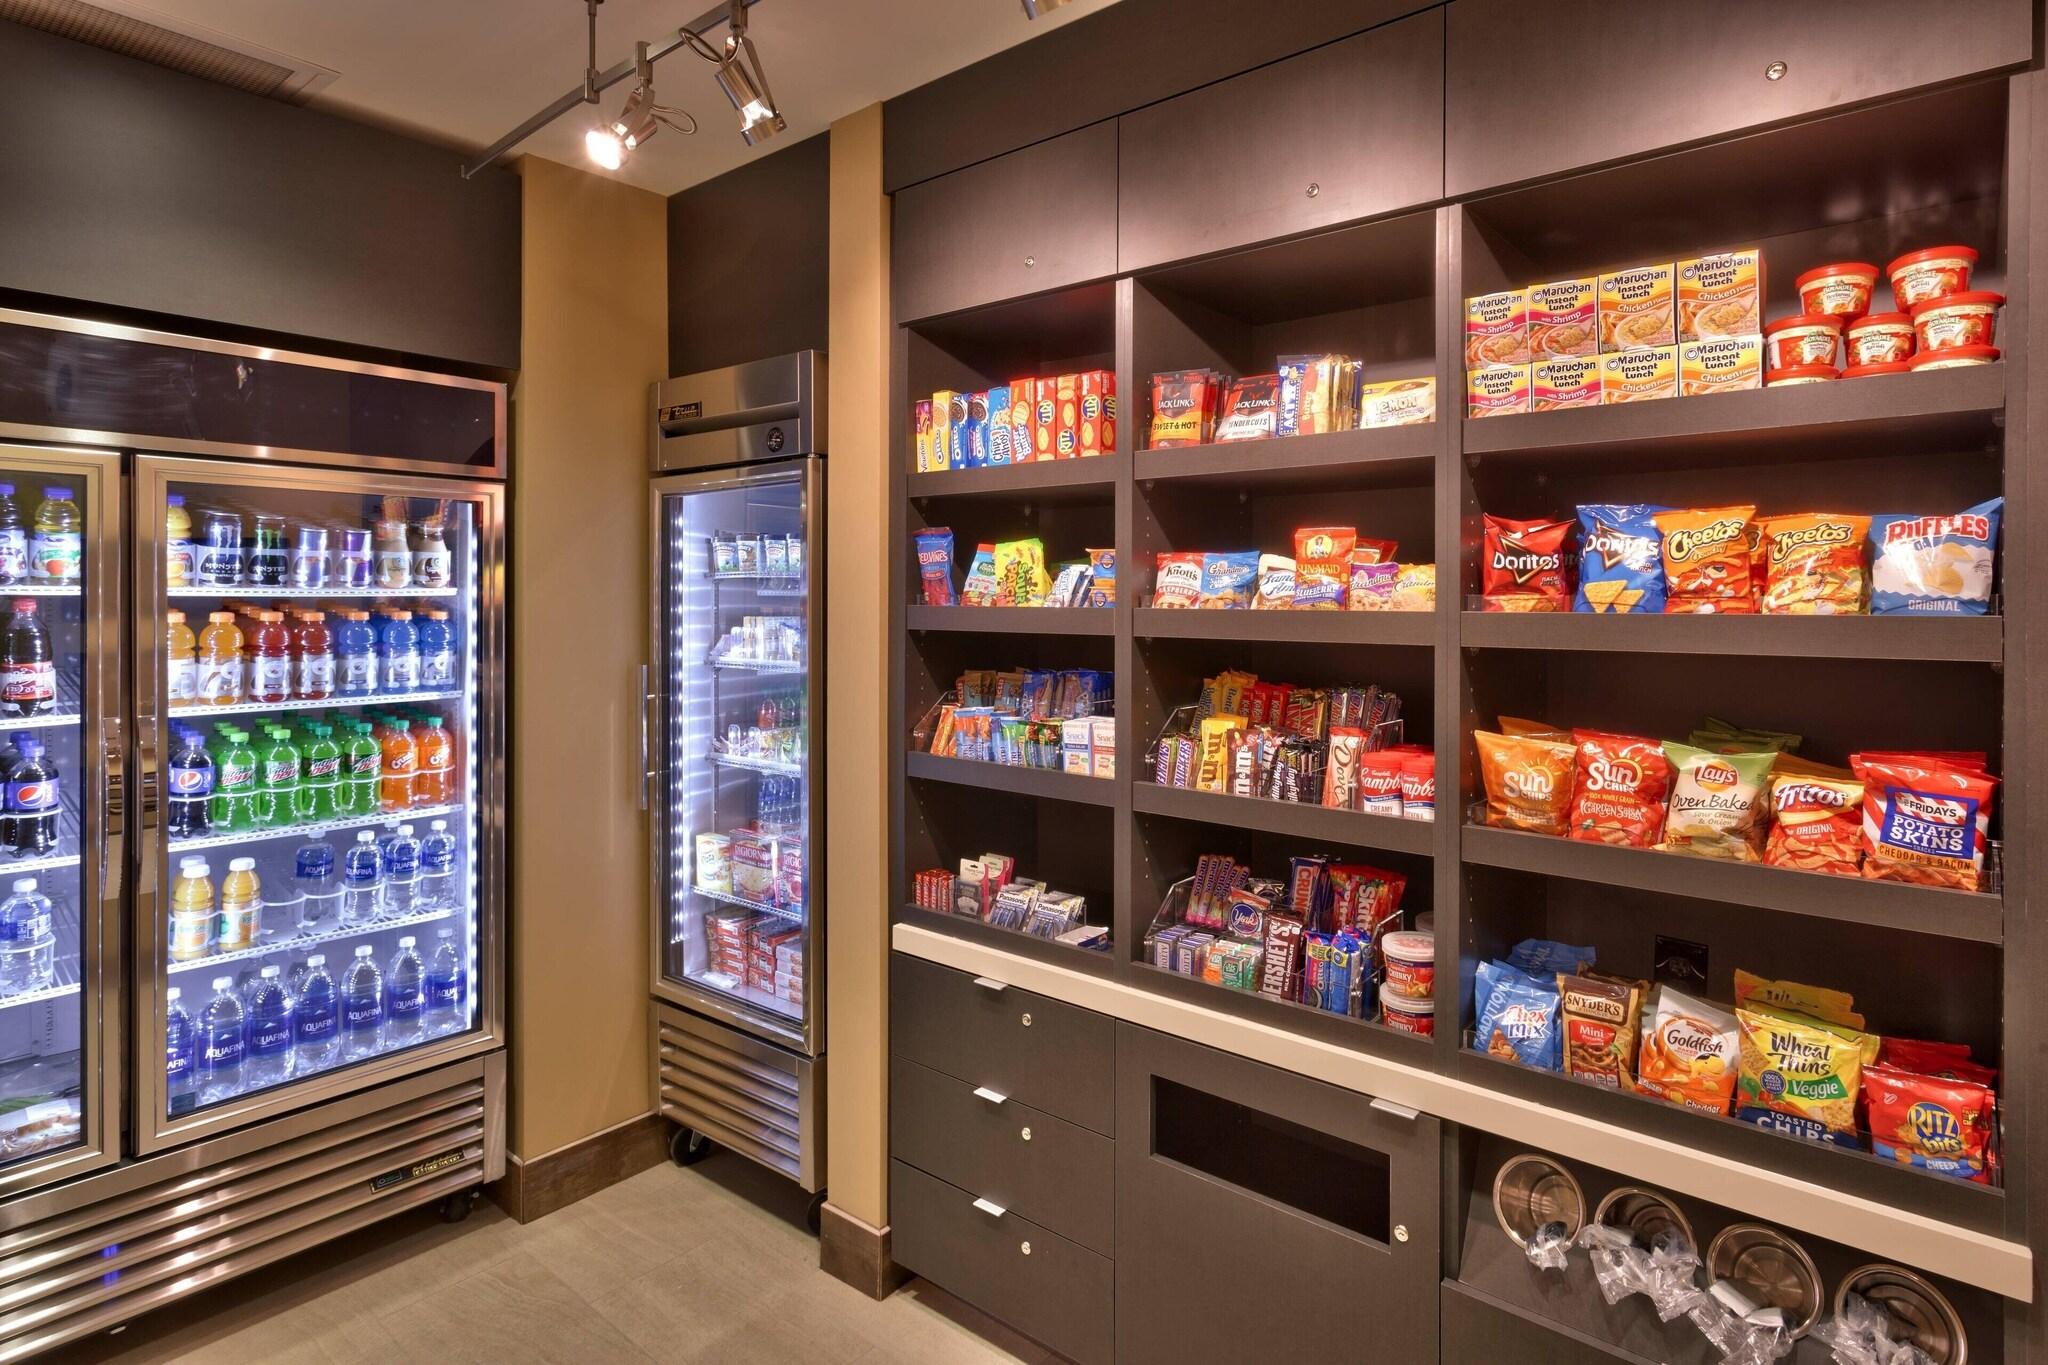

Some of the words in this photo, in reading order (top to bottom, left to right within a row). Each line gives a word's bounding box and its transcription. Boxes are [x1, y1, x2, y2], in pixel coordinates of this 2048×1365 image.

[1693, 256, 1751, 273] Maruchan
[1614, 270, 1667, 285] Maruchan
[1698, 268, 1737, 281] Instant
[1618, 282, 1654, 293] Instant
[1702, 278, 1733, 288] Lunch
[1542, 284, 1591, 298] Maruchan
[1621, 290, 1650, 300] Lunch
[1698, 287, 1736, 301] Chicken
[1478, 295, 1522, 308] Maruchan
[1545, 295, 1578, 305] Instant
[1549, 302, 1575, 311] Lunch
[1618, 299, 1652, 313] Chicken
[1481, 306, 1511, 316] Instant
[1484, 313, 1508, 322] Lunch
[1552, 311, 1581, 324] Shrimp
[1487, 321, 1514, 334] Shrimp
[1697, 340, 1754, 354] Maruchan
[1618, 352, 1670, 365] Maruchan
[1701, 351, 1740, 363] Instant
[1705, 360, 1736, 369] Lunch
[1547, 362, 1596, 374] Maruchan
[1621, 363, 1658, 373] Instant
[1625, 370, 1654, 379] Lunch
[1481, 370, 1523, 382] Maruchan
[1550, 372, 1584, 382] Instant
[1554, 379, 1580, 388] Lunch
[1701, 371, 1738, 383] Chicken
[1484, 380, 1513, 389] Instant
[1487, 387, 1510, 395] Lunch
[1621, 381, 1656, 392] Chicken
[1490, 394, 1516, 407] Shrimp
[1558, 388, 1588, 400] Shrimp
[1085, 397, 1097, 418] RITZ
[1158, 400, 1173, 409] JACK
[1233, 401, 1249, 410] JACK
[1040, 402, 1052, 423] RITZ
[1154, 422, 1174, 431] SWEET
[1174, 422, 1179, 430] &
[1181, 422, 1197, 430] HOT
[935, 430, 944, 463] OREO
[953, 426, 961, 461] OREO
[975, 426, 984, 460] OREO
[1060, 431, 1072, 451] RITZ
[993, 437, 1003, 461] Chips
[1887, 514, 1989, 543] RUFFLES
[1585, 535, 1659, 557] Doritos
[1668, 521, 1743, 561] Cheetos
[1772, 525, 1852, 563] Cheetos
[1494, 552, 1559, 571] Doritos
[1166, 566, 1198, 582] Knott's
[1016, 562, 1027, 604] SOUR
[1908, 599, 1961, 613] ORIGINAL
[1066, 731, 1086, 741] Snack
[1586, 761, 1638, 791] Sun
[1697, 765, 1737, 784] Lay's
[1504, 770, 1553, 797] Sun
[1603, 781, 1635, 794] CHIPS
[1520, 791, 1552, 801] CHIPS
[1673, 793, 1709, 809] Oven
[1775, 783, 1848, 811] Fritos
[1909, 800, 1957, 817] FRIDAYS
[1796, 823, 1835, 834] ORIGINAL
[1893, 815, 1964, 838] POTATO
[1889, 827, 1963, 851] SKINS
[1879, 846, 1922, 863] CHEDDAR
[1937, 858, 1971, 870] BACON
[1194, 859, 1208, 897] mentos
[1205, 860, 1218, 893] mentos
[1214, 860, 1232, 897] mentos
[1000, 893, 1027, 905] Panasonic
[1038, 903, 1067, 916] Panasonic
[1233, 909, 1258, 927] York
[1263, 925, 1290, 996] ERSHEY'S
[1567, 995, 1621, 1016] SNYDER'S
[348, 1006, 382, 1021] AQUAFINA
[1507, 1004, 1547, 1023] Chex
[302, 1016, 336, 1032] AQUAFINA
[1580, 1025, 1604, 1038] Mini
[252, 1029, 290, 1045] AQUAFINA
[1667, 1029, 1724, 1053] Goldfish
[205, 1041, 246, 1059] AQUAFINA
[1771, 1031, 1833, 1061] Wheat
[1767, 1053, 1831, 1075] Thins
[1792, 1080, 1839, 1100] Veggie
[1686, 1099, 1720, 1114] Cheddar
[1770, 1112, 1822, 1131] TOASTED
[1910, 1105, 1956, 1137] RITZ
[1921, 1137, 1960, 1153] bits
